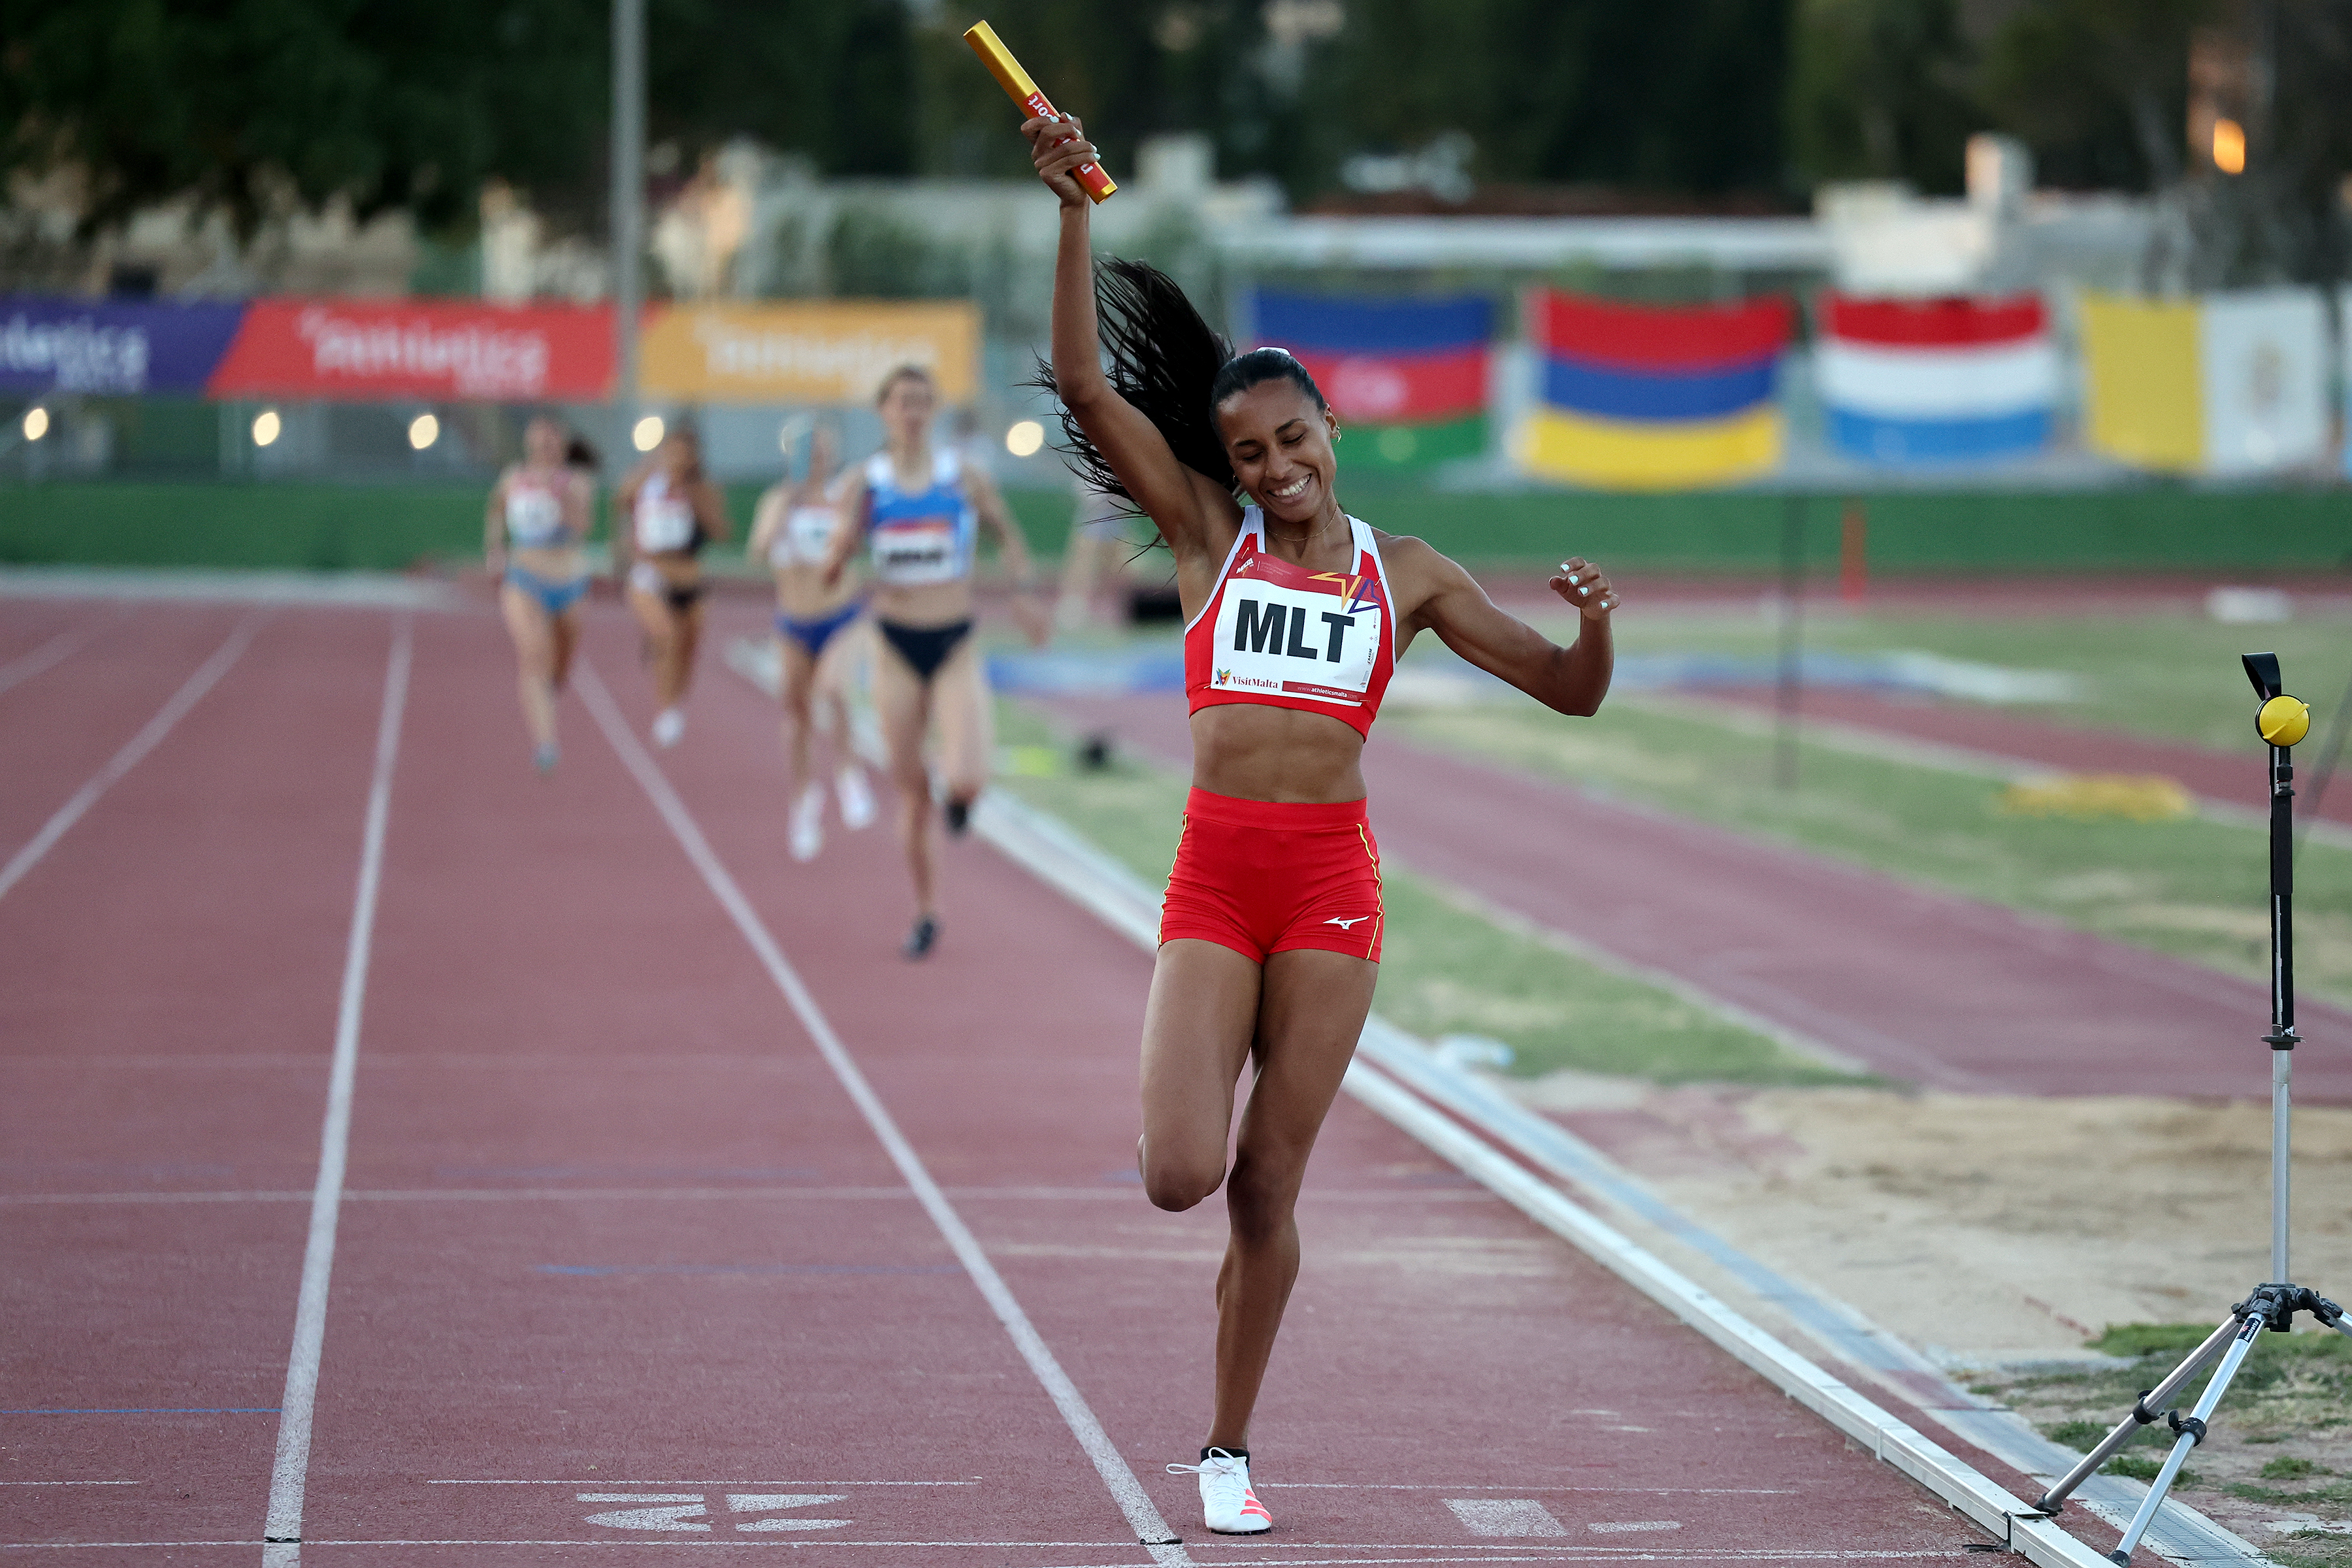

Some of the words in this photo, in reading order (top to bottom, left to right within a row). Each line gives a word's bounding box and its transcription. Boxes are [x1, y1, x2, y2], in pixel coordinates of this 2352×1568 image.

[1233, 598, 1355, 663] MLT
[1232, 676, 1279, 689] VisitMalta
[1297, 686, 1358, 700] www.athleticsmalta.com
[2244, 1320, 2259, 1341] Manfrotto
